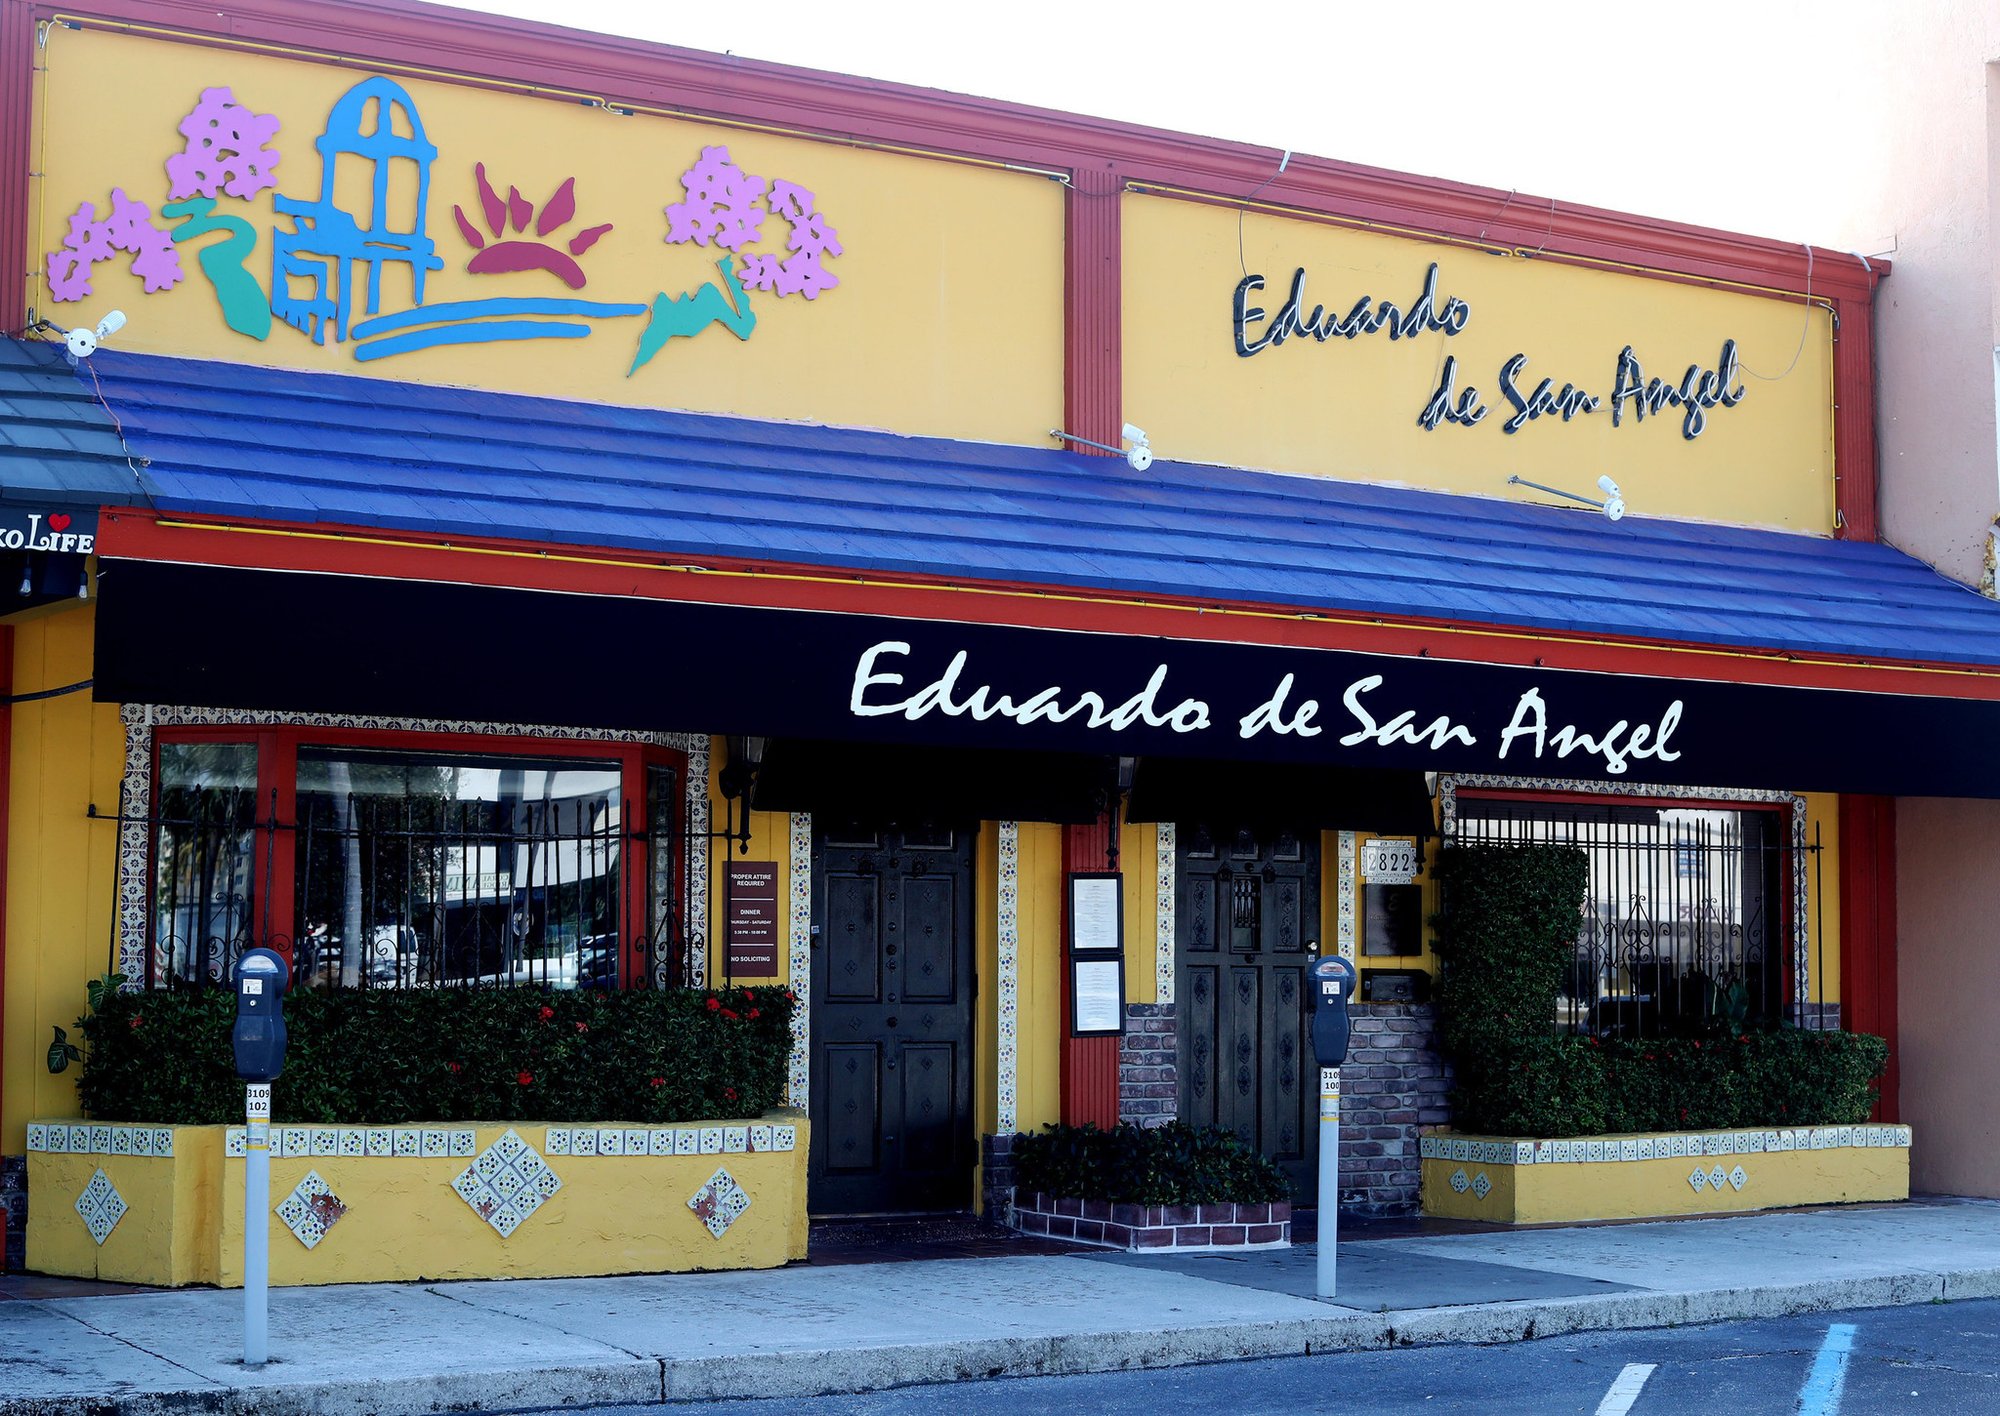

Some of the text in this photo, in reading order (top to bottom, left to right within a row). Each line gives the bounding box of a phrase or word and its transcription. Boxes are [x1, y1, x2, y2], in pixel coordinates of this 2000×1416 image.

[1233, 263, 1470, 358] Eduardo
[1416, 338, 1745, 440] de San Angel
[851, 641, 1683, 774] Eduardo de San Angel
[1368, 853, 1410, 872] 2822
[248, 1089, 269, 1098] 3109
[1325, 1081, 1340, 1090] 100
[250, 1101, 267, 1111] 102
